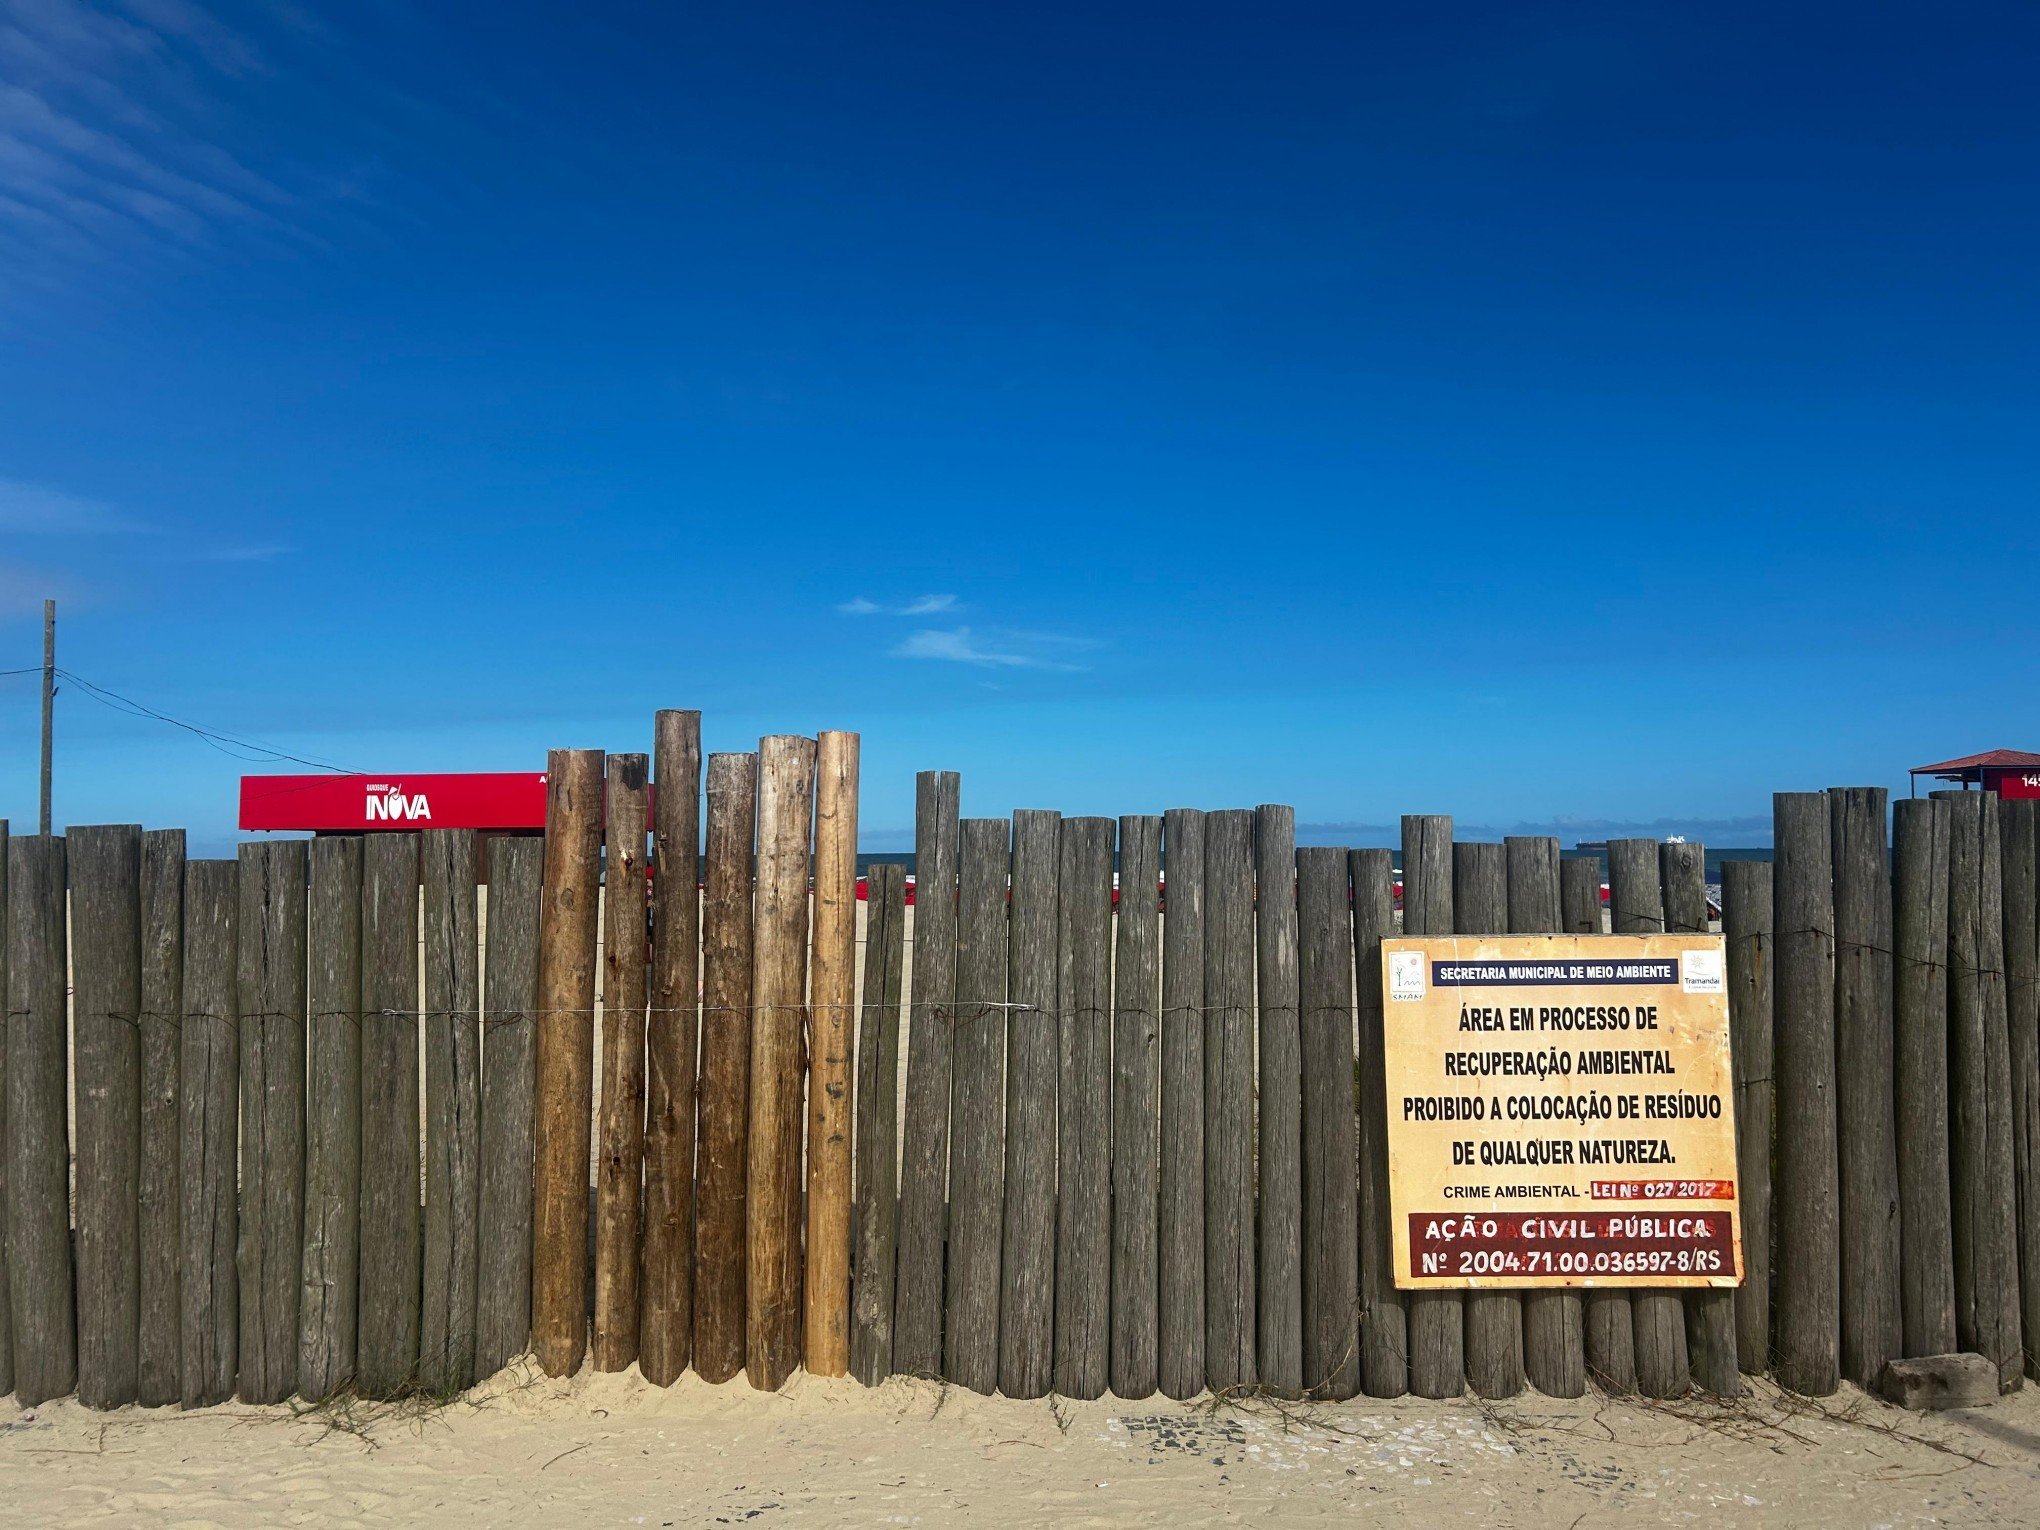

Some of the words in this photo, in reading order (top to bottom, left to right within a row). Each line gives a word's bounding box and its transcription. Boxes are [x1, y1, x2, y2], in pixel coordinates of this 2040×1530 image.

[366, 783, 389, 791] QUIOSQUE
[2021, 774, 2040, 787] 14
[366, 794, 432, 820] INOVA
[1440, 967, 1507, 980] SECRETARIA
[1508, 966, 1567, 979] MUNICIPAL
[1569, 966, 1584, 979] DE
[1586, 965, 1614, 978] MEIO
[1616, 965, 1671, 978] AMBIENTE
[1459, 1002, 1504, 1031] ÁREA
[1510, 1007, 1534, 1031] EM
[1540, 1006, 1630, 1031] PROCESSO
[1636, 1006, 1658, 1030] DE
[1445, 1046, 1572, 1081] RECUPERAÇÃO
[1577, 1050, 1675, 1075] AMBIENTAL
[1403, 1096, 1484, 1121] PROIBIDO
[1490, 1096, 1502, 1120] A
[1507, 1090, 1612, 1125] COLOCAÇÃO
[1617, 1095, 1640, 1119] DE
[1645, 1089, 1721, 1119] RESÍDUO
[1452, 1141, 1475, 1165] DE
[1480, 1140, 1573, 1166] QUALQUER
[1579, 1139, 1676, 1164] NATUREZA.
[1443, 1186, 1490, 1198] CRIME
[1494, 1185, 1580, 1198] AMBIENTAL
[1593, 1183, 1616, 1197] LEI
[1644, 1182, 1716, 1197] 027/2017
[1425, 1214, 1498, 1241] AÇÃO
[1521, 1219, 1595, 1239] CIVIL
[1609, 1214, 1710, 1238] PÚBLICA
[1422, 1252, 1447, 1274] Nº
[1459, 1247, 1721, 1273] 2004.71.00.036597-8/RS
